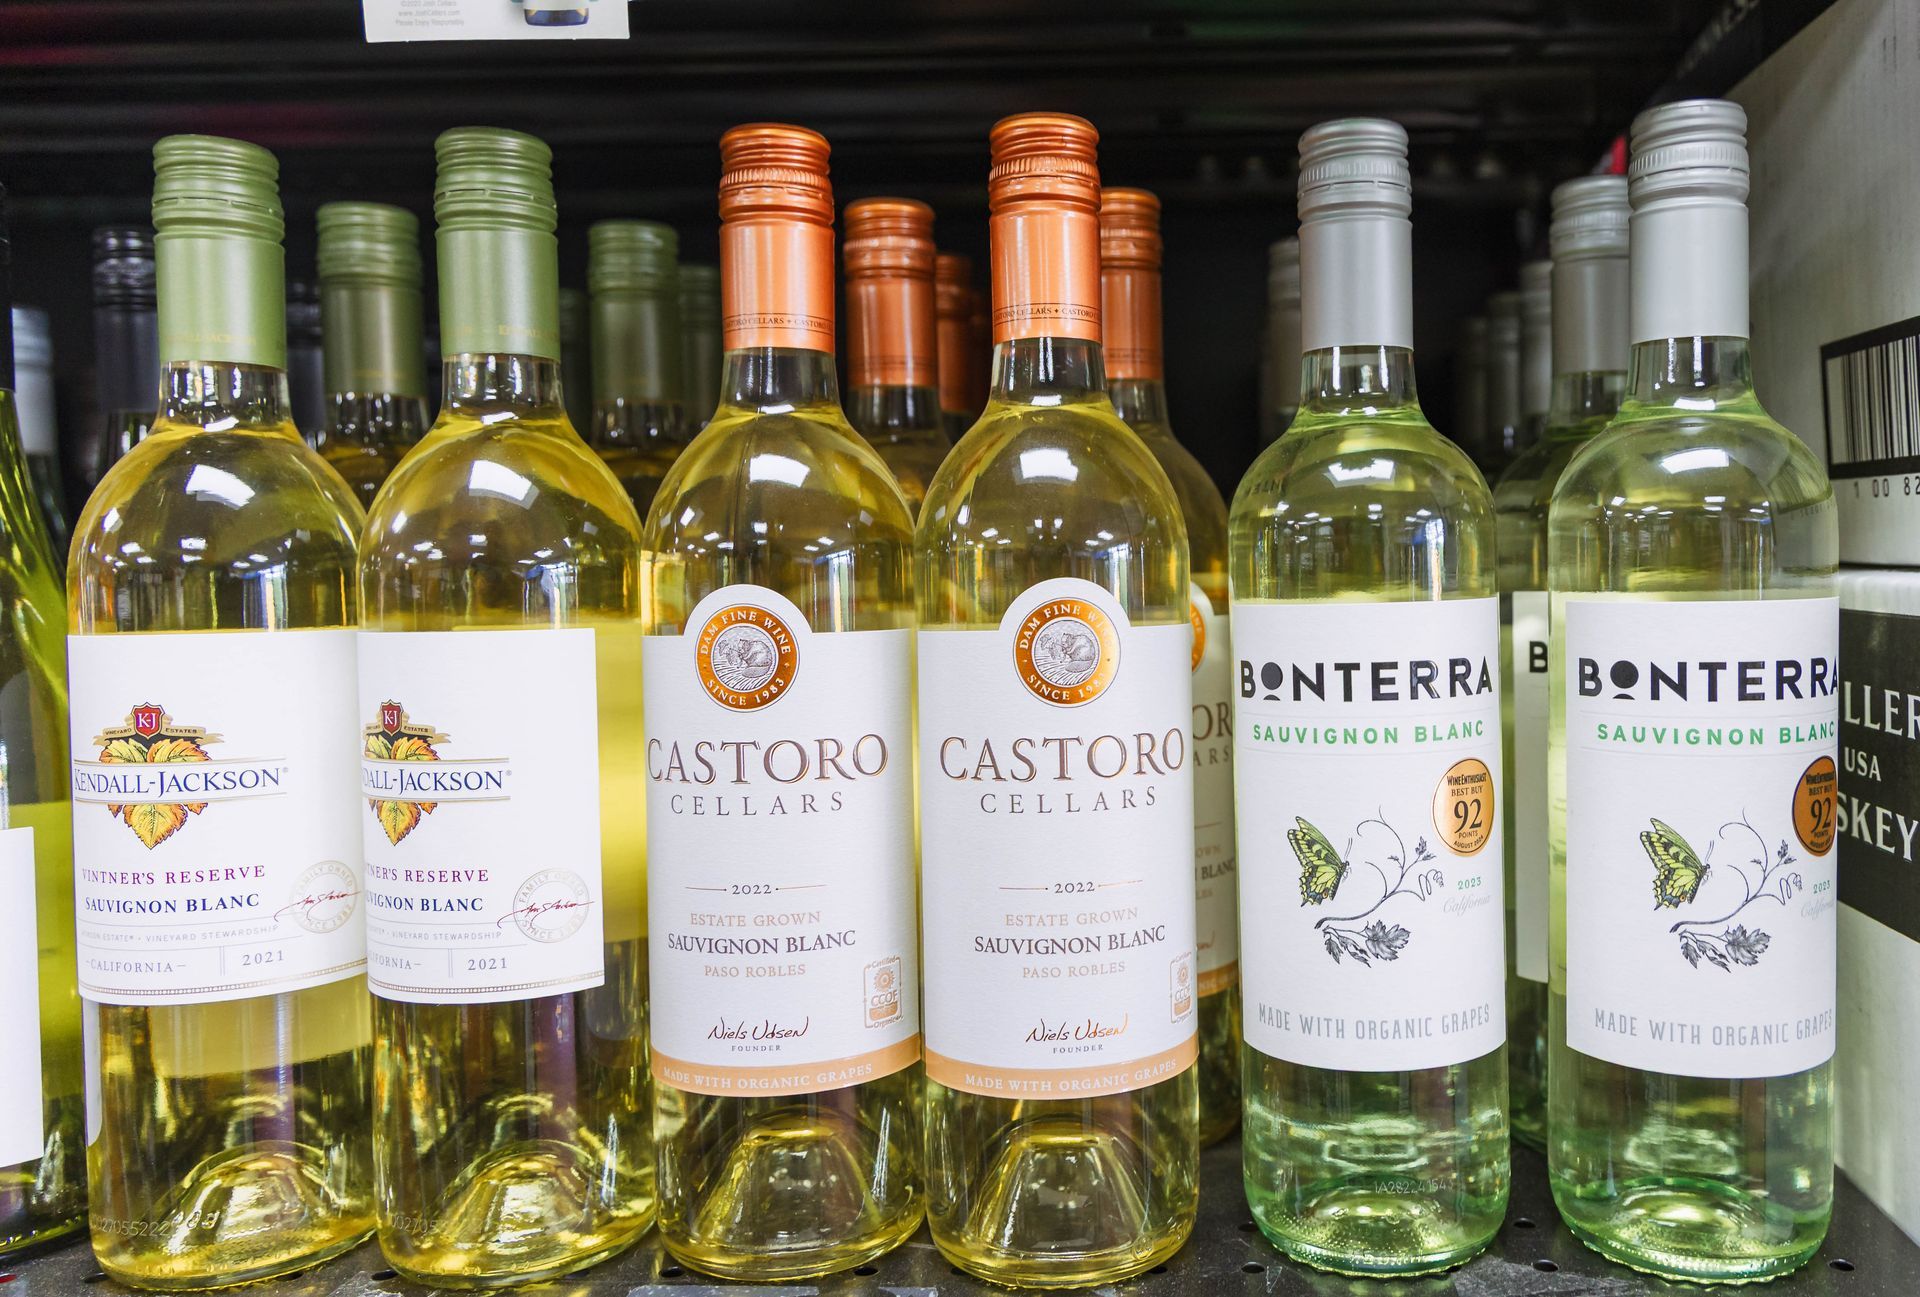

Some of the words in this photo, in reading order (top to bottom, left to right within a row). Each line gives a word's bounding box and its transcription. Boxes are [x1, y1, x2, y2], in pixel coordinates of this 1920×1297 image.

[700, 624, 719, 655] DAM
[721, 610, 757, 625] FINE
[763, 617, 791, 655] WINE
[1020, 617, 1041, 650] DAM
[1043, 603, 1081, 619] FINE
[1027, 674, 1070, 700] SINCE
[1240, 656, 1493, 703] BONTERRA
[707, 679, 747, 706] SINCE
[754, 678, 785, 703] 1983
[138, 712, 156, 730] K-J
[384, 710, 397, 727] K-J
[165, 727, 198, 735] ESTATES
[1253, 724, 1398, 744] SAUVIGNON
[1415, 719, 1484, 743] BLANC
[1597, 723, 1763, 745] SAUVIGNON
[1779, 721, 1835, 744] BLANC
[647, 733, 889, 786] CASTORO
[939, 727, 1185, 782] CASTORO
[1844, 747, 1882, 782] USA
[980, 786, 1156, 814] CELLARS
[1451, 787, 1469, 797] BEST
[1471, 785, 1483, 795] BUY
[671, 791, 843, 816] CELLARS
[1454, 798, 1483, 834] 92
[1810, 797, 1832, 833] 92
[1453, 840, 1473, 849] AUGUST
[1458, 830, 1479, 839] POINTS
[81, 867, 155, 885] VINTNER'S
[165, 865, 266, 885] RESERVE
[405, 869, 489, 883] RESERVE
[1458, 876, 1482, 890] 2023
[732, 884, 772, 895] 2022
[1054, 881, 1096, 894] 2022
[1813, 880, 1831, 894] 2023
[85, 897, 177, 914] SAUVIGNON
[186, 893, 260, 913] BLANC
[420, 897, 483, 912] BLANC
[690, 912, 747, 928] ESTATE
[753, 911, 821, 927] GROWN
[1005, 914, 1069, 927] ESTATE
[1076, 907, 1138, 926] GROWN
[146, 933, 197, 943] VINEYARD
[202, 924, 279, 940] STEWARDSHIP
[392, 930, 430, 941] VINEYARD
[433, 931, 502, 941] STEWARDSHIP
[668, 932, 779, 955] SAUVIGNON
[786, 930, 856, 954] BLANC
[974, 935, 1101, 955] SAUVIGNON
[1108, 925, 1166, 951] BLANC
[242, 950, 285, 966] 2021
[468, 958, 508, 971] 2021
[704, 964, 740, 978] PASO
[745, 963, 807, 978] ROBLES
[1022, 966, 1062, 979] PASO
[1068, 961, 1126, 978] ROBLES
[1258, 1002, 1291, 1031] MADE
[1300, 1014, 1345, 1039] WITH
[1356, 1017, 1433, 1040] ORGANIC
[1441, 1003, 1490, 1035] GRAPES
[1595, 1008, 1638, 1037] MADE
[1649, 1019, 1701, 1045] WITH
[1712, 1022, 1789, 1046] ORGANIC
[1796, 1008, 1832, 1040] GRAPES
[731, 1044, 782, 1053] FOUNDER
[1053, 1044, 1104, 1054] FOUNDER
[663, 1066, 690, 1084] MADE
[693, 1074, 731, 1090] WITH
[738, 1075, 810, 1090] ORGANIC
[816, 1063, 873, 1085] GRAPES
[965, 1073, 1004, 1089] MADE
[1008, 1079, 1052, 1092] WITH
[1059, 1073, 1129, 1092] ORGANIC
[1135, 1059, 1177, 1082] GRAPES
